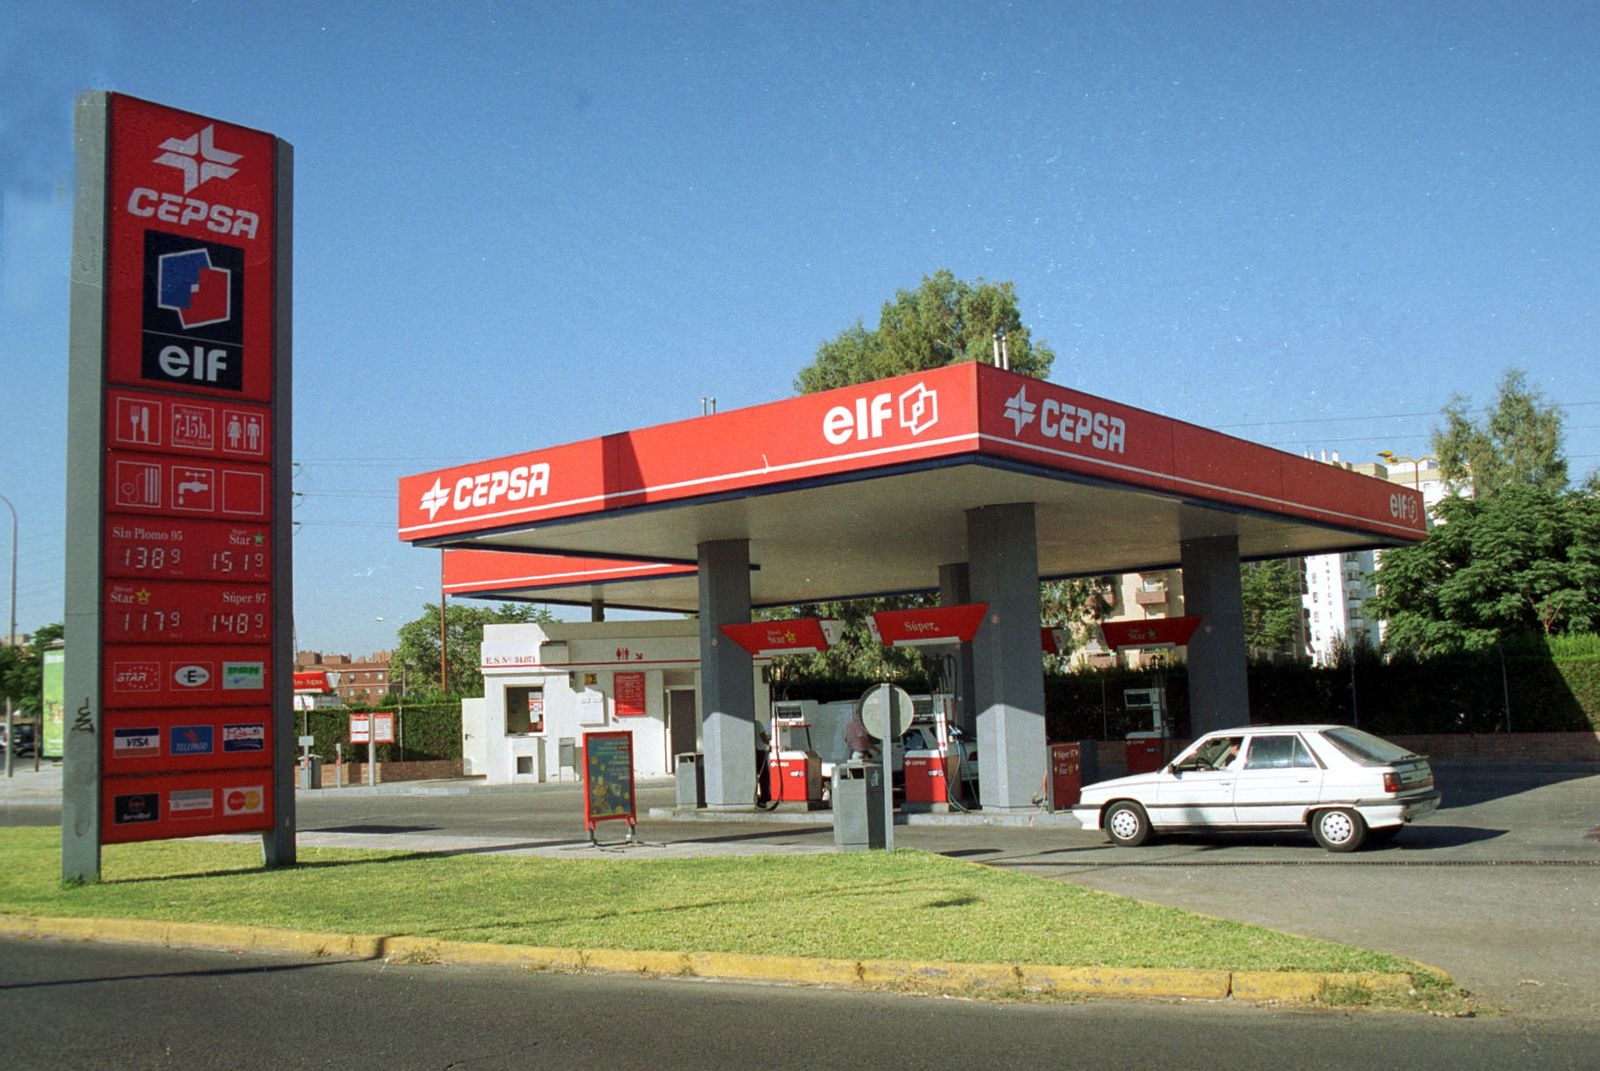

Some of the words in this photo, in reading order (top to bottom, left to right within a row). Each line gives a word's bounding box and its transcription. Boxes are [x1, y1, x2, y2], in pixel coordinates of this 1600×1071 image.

[127, 187, 259, 239] CEPSA
[158, 345, 227, 381] elf
[823, 393, 891, 445] elf
[1040, 399, 1126, 454] CEPSA
[453, 462, 550, 511] CEPSA
[1390, 493, 1407, 520] elf
[112, 527, 132, 539] Sin
[134, 527, 168, 540] Plomo
[171, 530, 183, 541] 95
[229, 534, 251, 545] Star
[111, 592, 135, 604] Star
[223, 592, 253, 606] Súper
[904, 621, 935, 633] Súper
[116, 672, 148, 682] STAR
[126, 737, 149, 747] VISA
